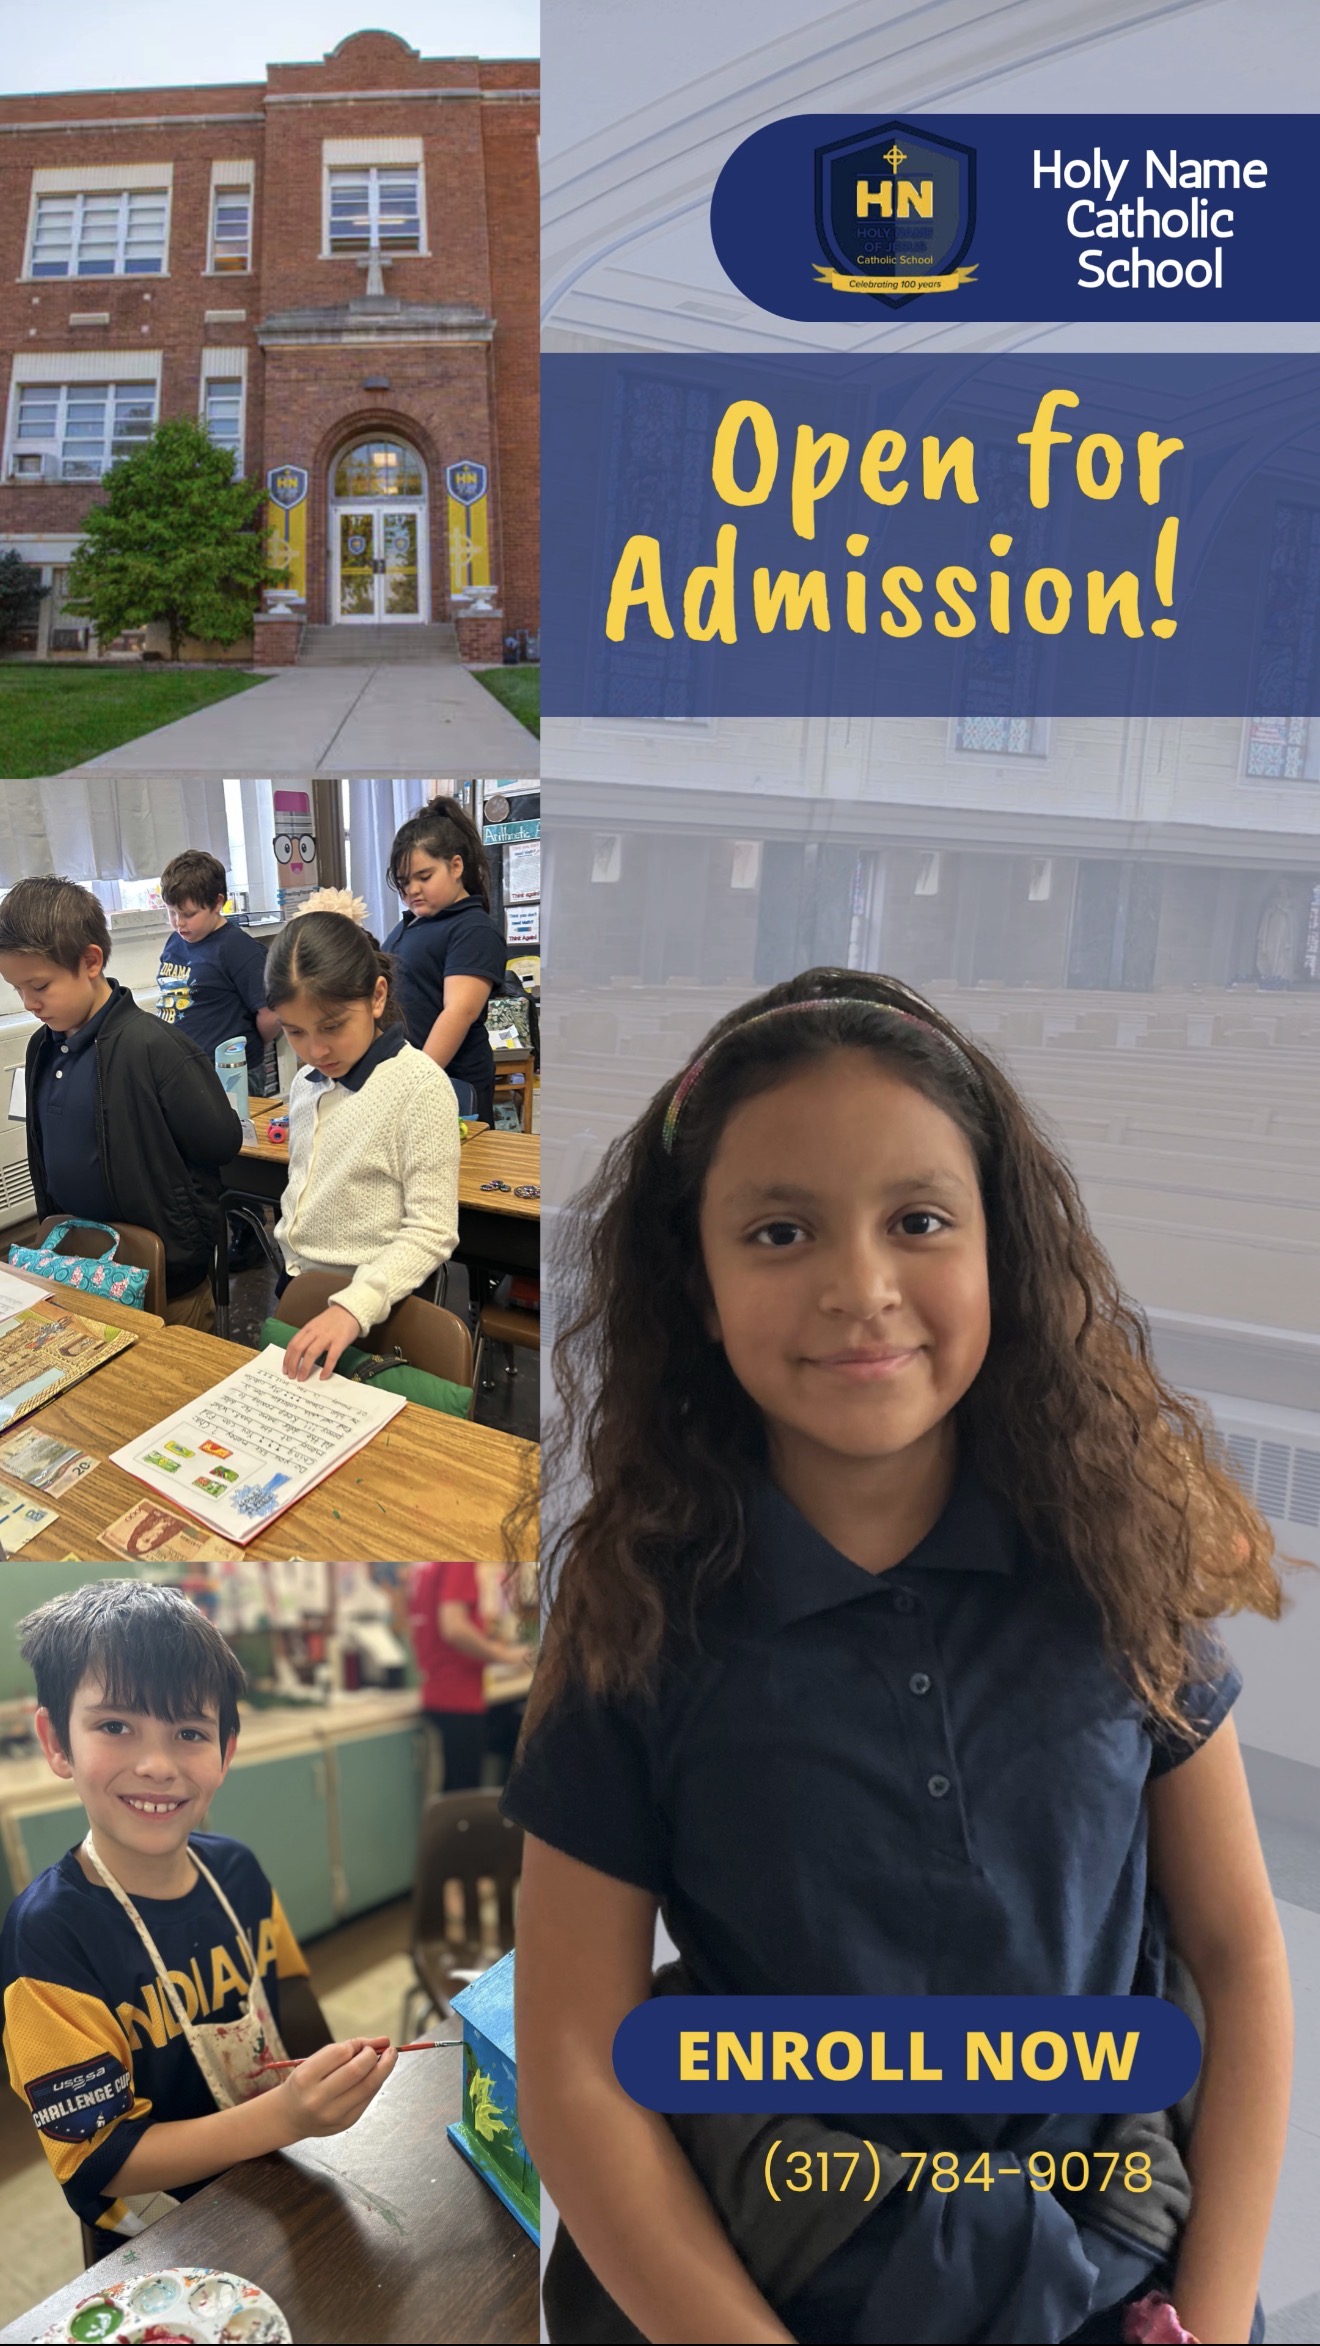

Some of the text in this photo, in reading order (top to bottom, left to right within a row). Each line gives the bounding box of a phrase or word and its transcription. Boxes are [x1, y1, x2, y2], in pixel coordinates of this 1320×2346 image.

[277, 476, 298, 488] HN
[455, 472, 477, 484] HN
[485, 826, 531, 843] Arithmetic
[160, 962, 191, 980] DRAMA
[221, 1417, 236, 1427] can
[276, 1408, 300, 1424] Keep
[225, 1429, 250, 1445] money
[239, 1428, 254, 1438] You
[305, 1433, 320, 1443] the
[297, 1439, 325, 1456] money
[274, 1452, 292, 1464] you
[285, 1446, 316, 1466] Ching
[72, 1461, 91, 1476] 20
[32, 2072, 131, 2128] CHALLENGE CUP
